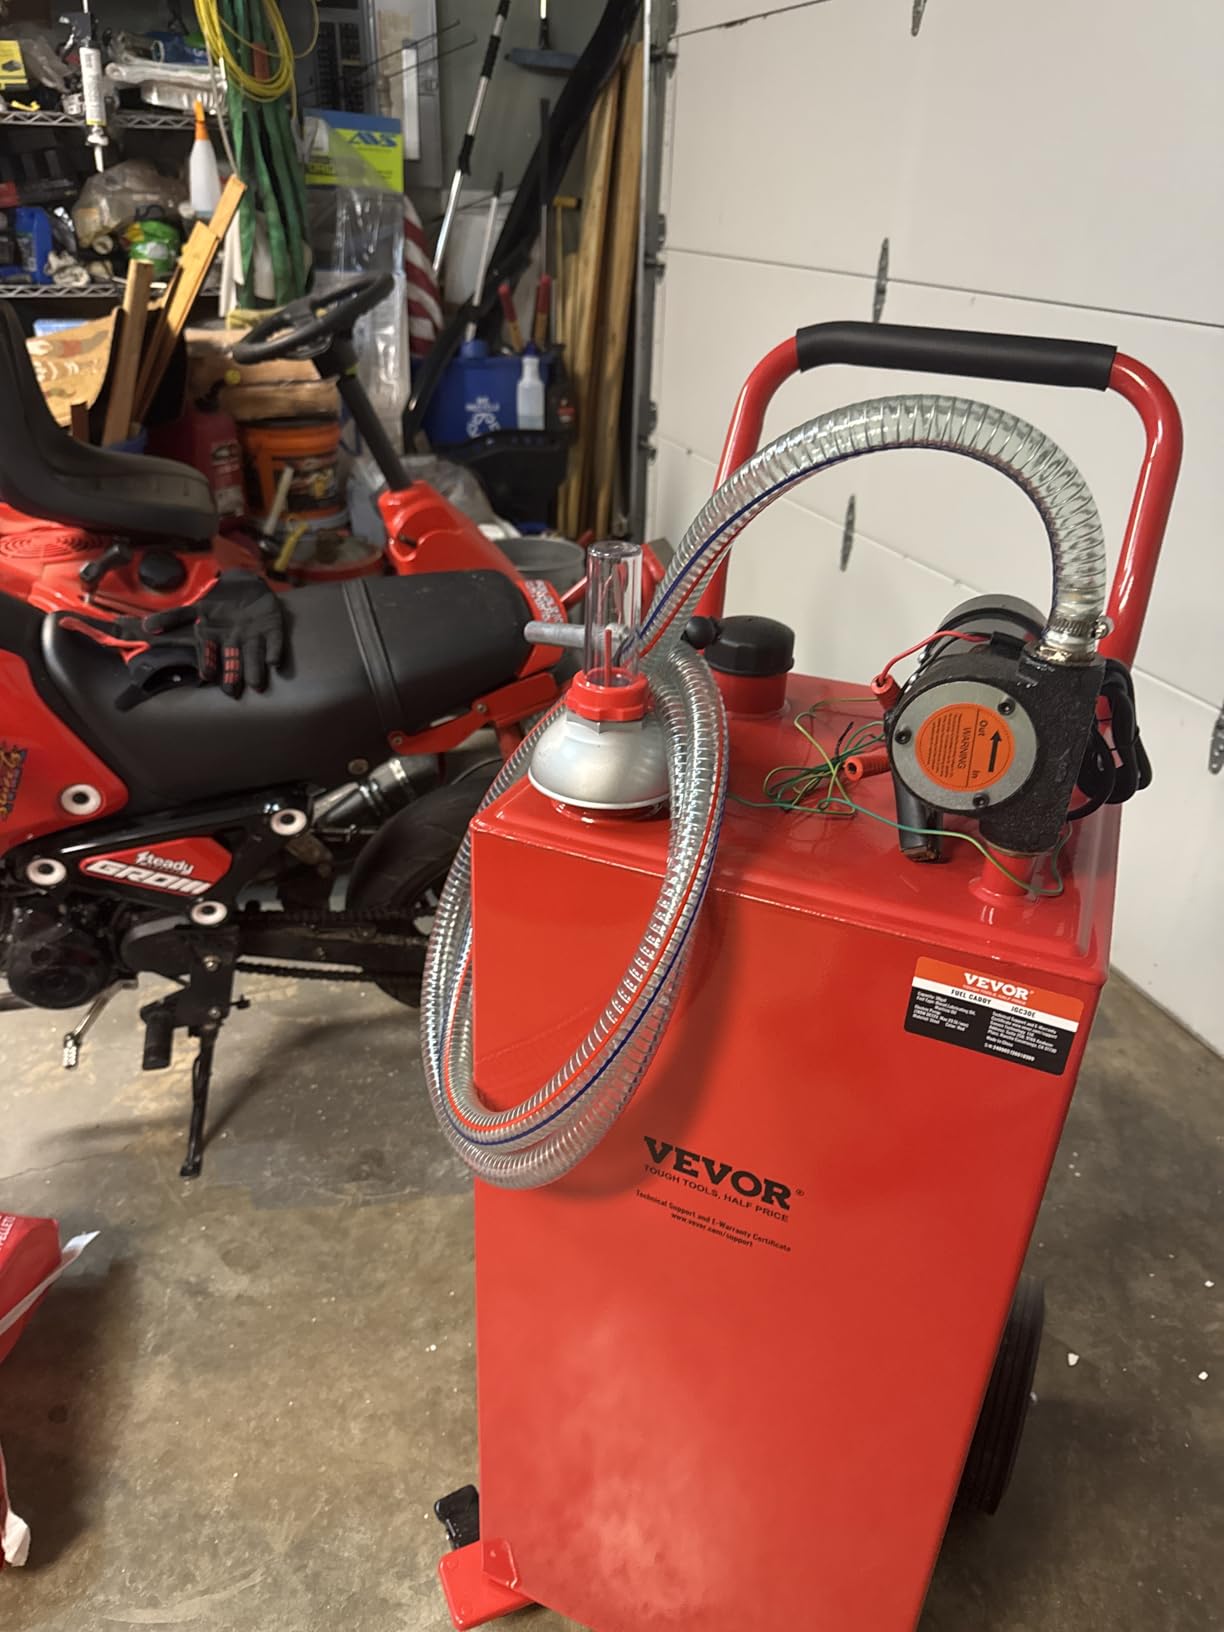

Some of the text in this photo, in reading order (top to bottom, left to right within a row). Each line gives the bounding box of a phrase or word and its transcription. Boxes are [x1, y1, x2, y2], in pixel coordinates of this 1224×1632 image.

[979, 720, 989, 737] Out
[957, 728, 972, 769] WARNING
[971, 770, 981, 779] In
[86, 860, 212, 895] GROM
[950, 989, 967, 999] FUEL
[969, 994, 992, 1005] CADDY
[963, 972, 1029, 1000] VEVOR
[643, 1135, 791, 1210] VEVOR
[643, 1164, 790, 1222] TOUGH TOOLS, HALF PRICE
[636, 1190, 668, 1208] Technical
[668, 1202, 697, 1218] Support
[698, 1212, 711, 1222] and
[752, 1233, 792, 1252] Certificate
